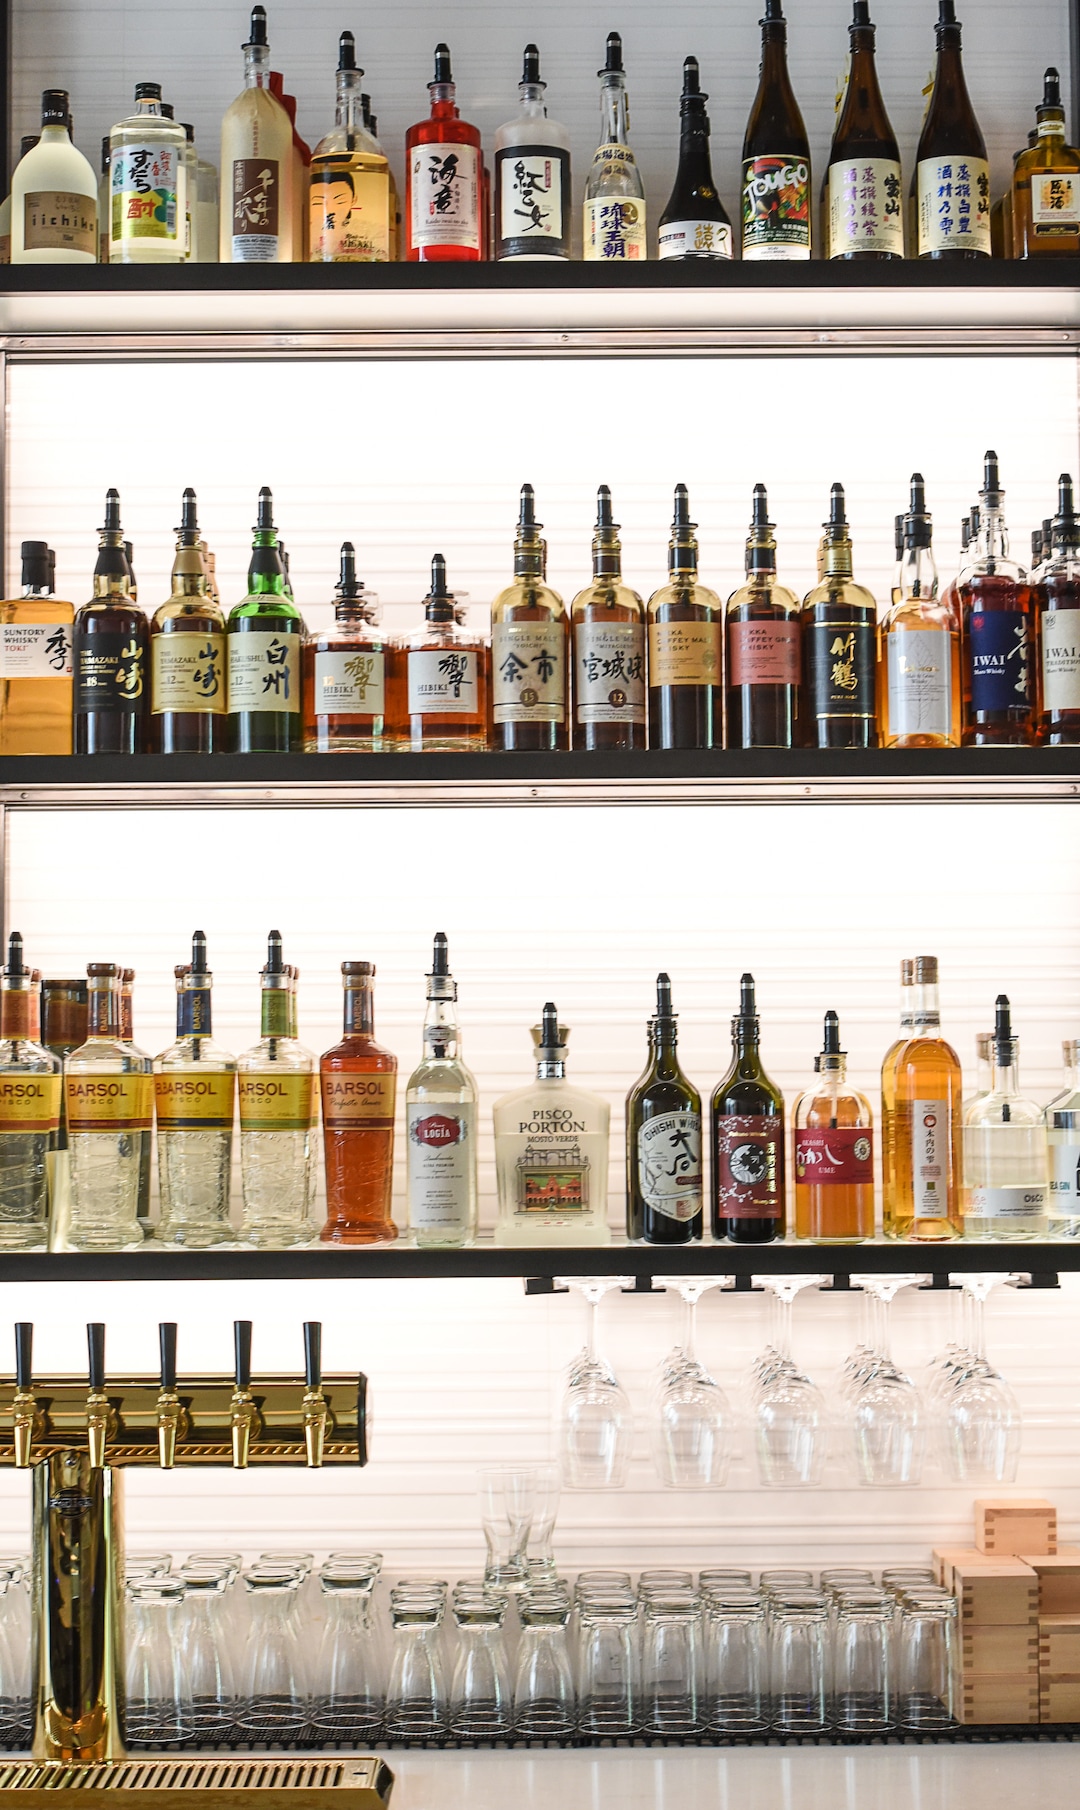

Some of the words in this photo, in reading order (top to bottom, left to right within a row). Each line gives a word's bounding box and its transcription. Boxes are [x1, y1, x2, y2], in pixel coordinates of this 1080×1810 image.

[128, 149, 154, 195] すだち
[427, 153, 468, 215] 海童
[1049, 179, 1065, 210] 原酒
[513, 160, 550, 232] 紅乙女
[883, 173, 900, 217] 宝山
[936, 165, 954, 236] 酒精乃雫
[127, 198, 157, 219] 酎
[32, 214, 94, 231] iichiko
[600, 203, 628, 259] 琉球王朝
[44, 627, 72, 670] 季
[1046, 647, 1077, 659] IWAI
[80, 656, 119, 664] YAMAZAKI
[115, 639, 144, 700] 山崎
[193, 642, 221, 698] 山崎
[262, 638, 290, 700] 白州
[499, 649, 558, 684] 余市
[582, 651, 644, 684] 宮城峡
[829, 632, 859, 691] 竹鶴
[973, 655, 1006, 667] IWAI
[86, 676, 98, 687] 18
[167, 675, 177, 684] 12
[235, 676, 244, 685] 12
[344, 655, 379, 700] 響
[438, 653, 473, 698] 響
[323, 686, 356, 694] HIBIKI
[417, 684, 449, 692] HIBIKI
[524, 692, 535, 702] 15
[611, 692, 624, 703] 12
[193, 995, 201, 1030] BARSOL
[0, 1084, 44, 1098] RSOL
[69, 1083, 128, 1097] BARSOL
[240, 1083, 288, 1096] ARSOL
[326, 1082, 385, 1095] BARSOL
[533, 1109, 573, 1120] PISCO
[424, 1127, 451, 1139] LOGÍA
[519, 1120, 586, 1134] PORTÓN
[644, 1120, 676, 1140] OHISHI
[679, 1118, 700, 1131] WHIS
